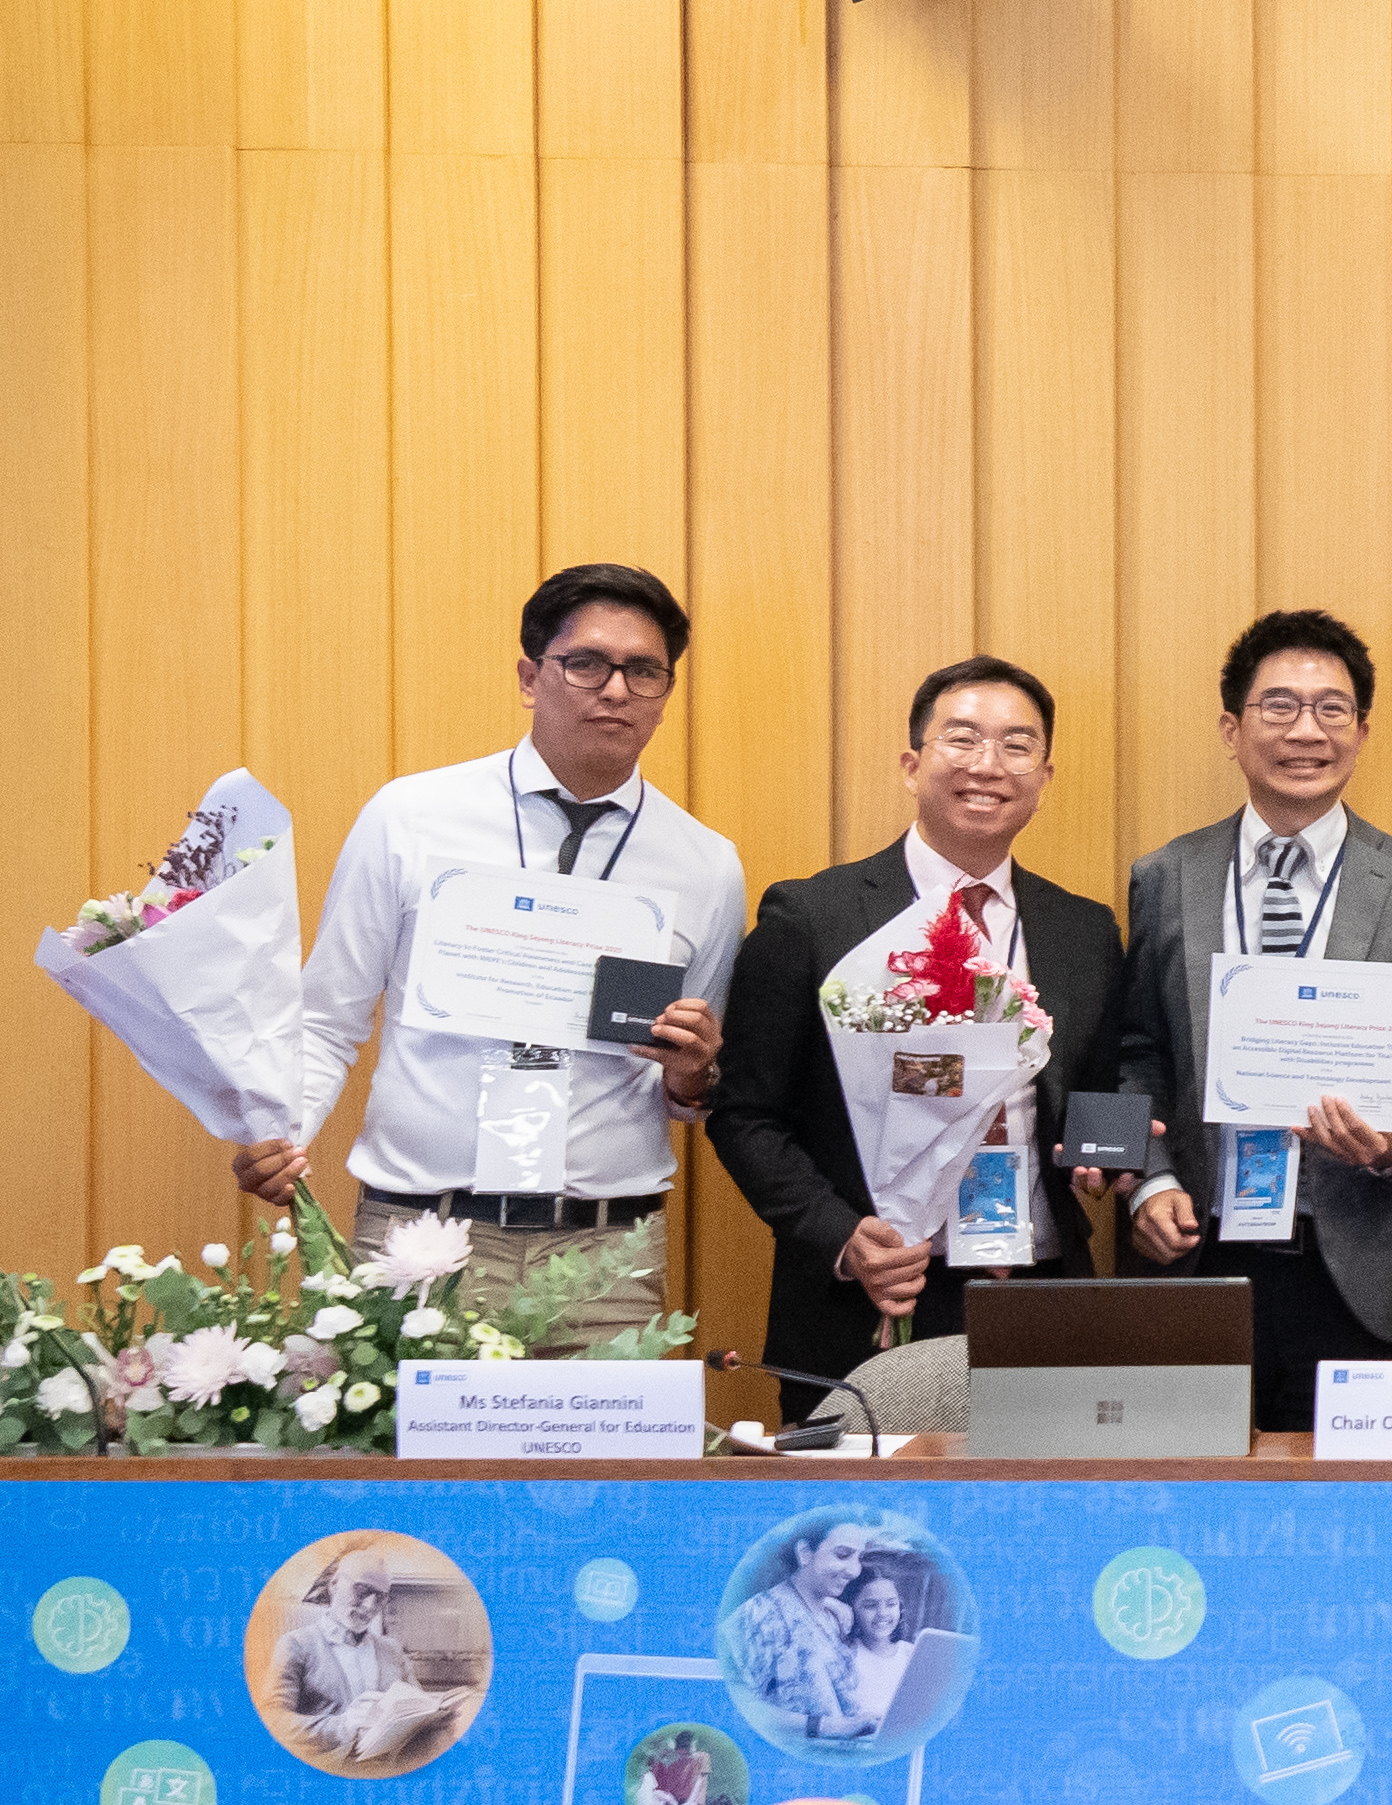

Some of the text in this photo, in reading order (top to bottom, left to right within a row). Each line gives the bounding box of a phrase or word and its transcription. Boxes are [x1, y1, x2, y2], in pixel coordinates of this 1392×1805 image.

[538, 903, 579, 915] unesco
[1320, 991, 1360, 1000] unesco
[459, 1394, 644, 1411] Ms Stefania Giannini
[408, 1420, 696, 1433] Assistant Director-General for Education
[1331, 1415, 1377, 1430] Chair
[522, 1441, 582, 1454] UNESCO
